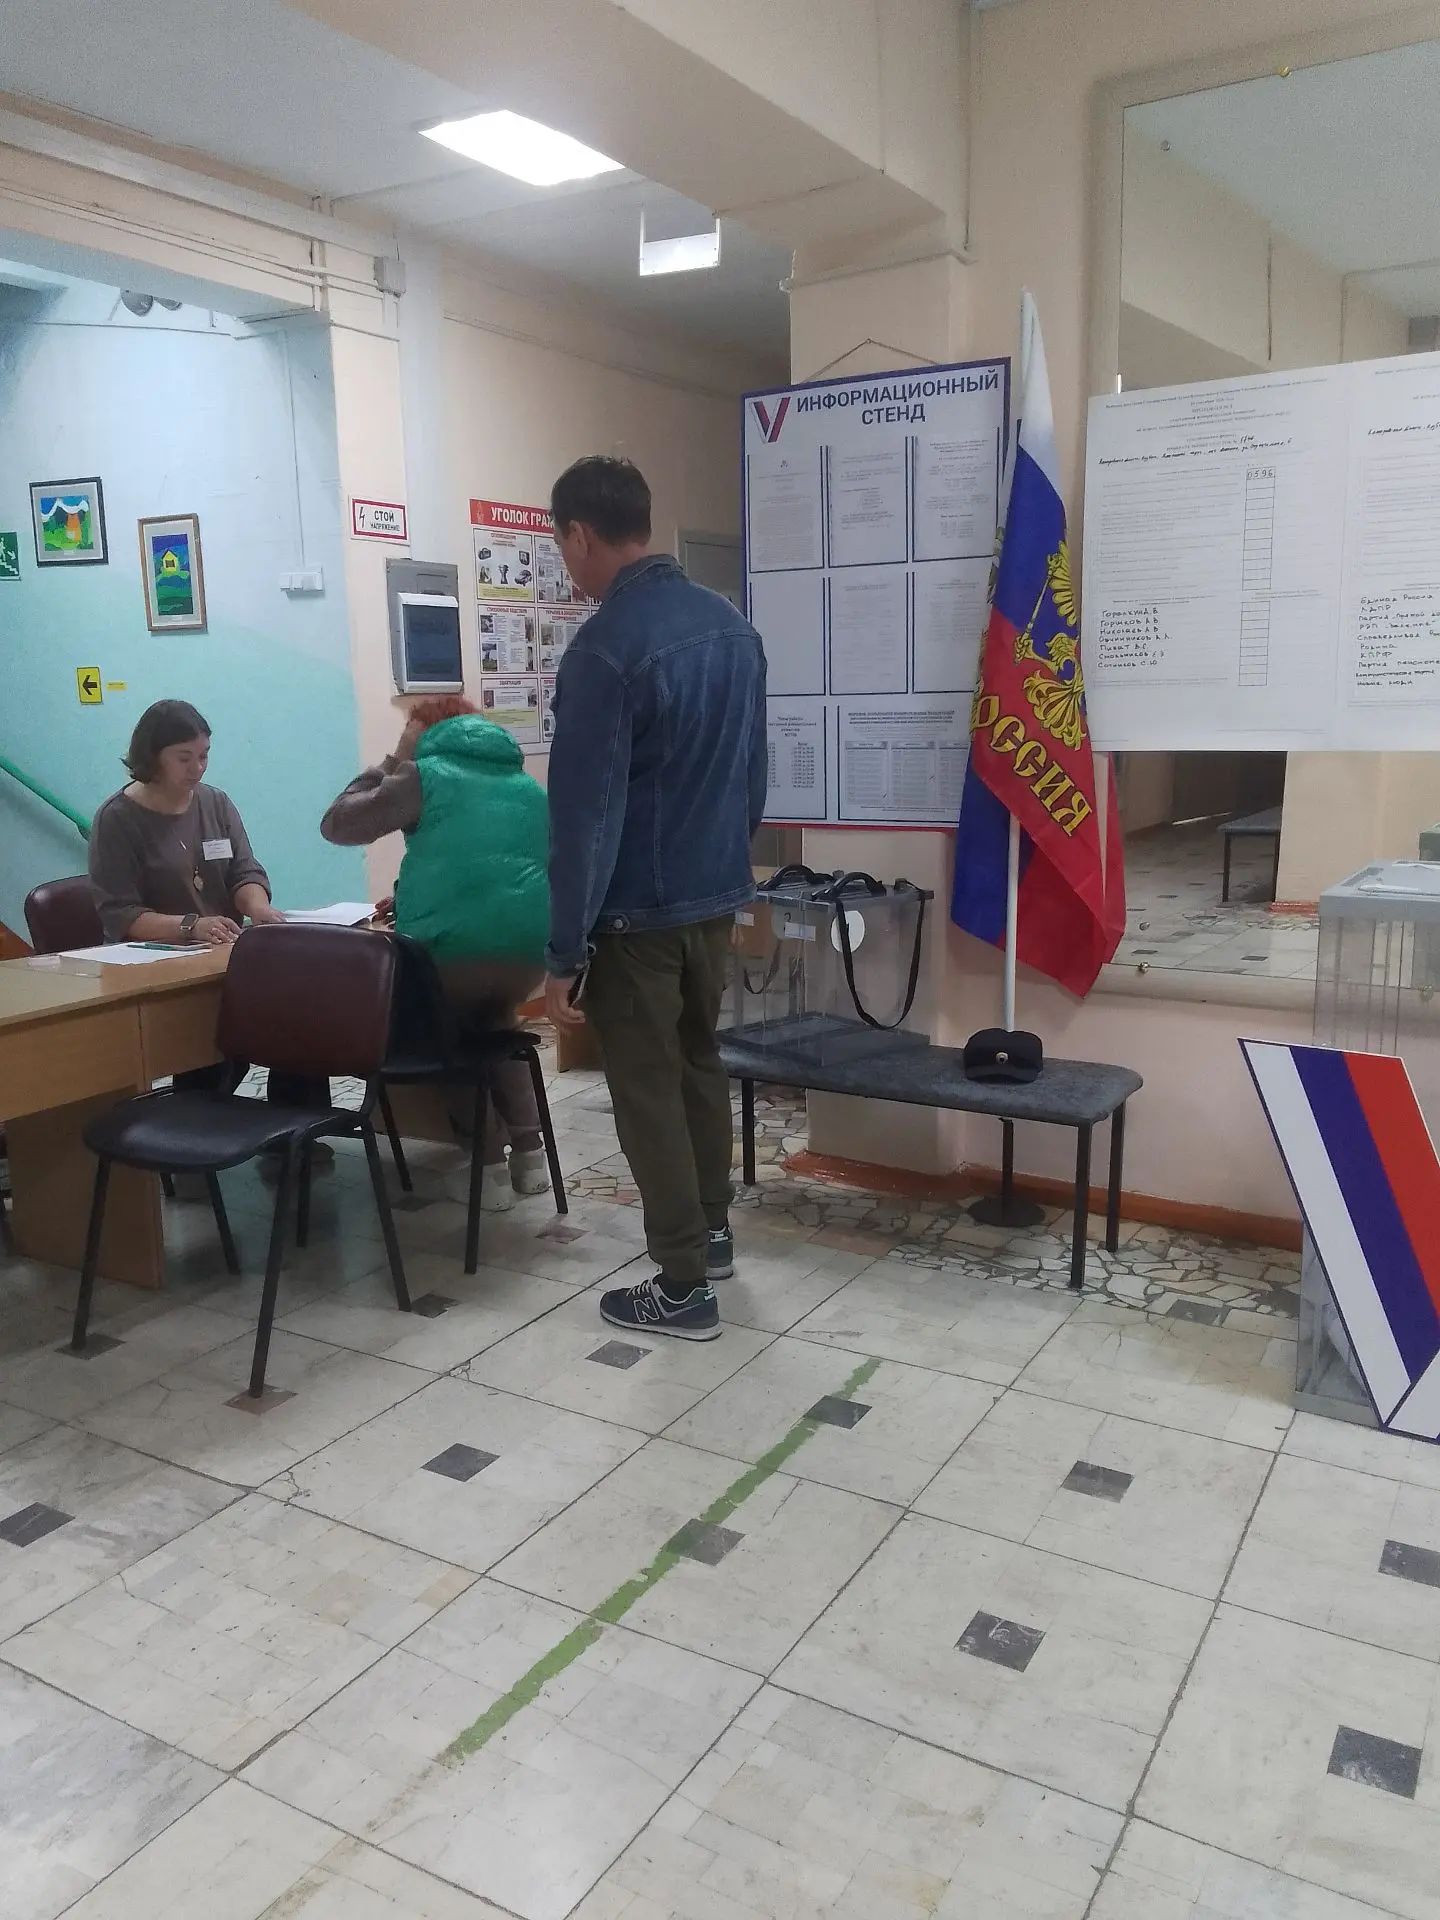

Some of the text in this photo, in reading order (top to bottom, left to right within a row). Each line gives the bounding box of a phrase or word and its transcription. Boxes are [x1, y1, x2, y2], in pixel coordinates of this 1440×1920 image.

[797, 369, 999, 413] ИНФОРМАЦИОННЫЙ
[861, 404, 926, 425] СТЕНД
[374, 510, 395, 522] СТОЙ
[491, 507, 529, 525] УГОЛОК
[973, 677, 1093, 838] ОССИЯ
[633, 1297, 659, 1322] N
